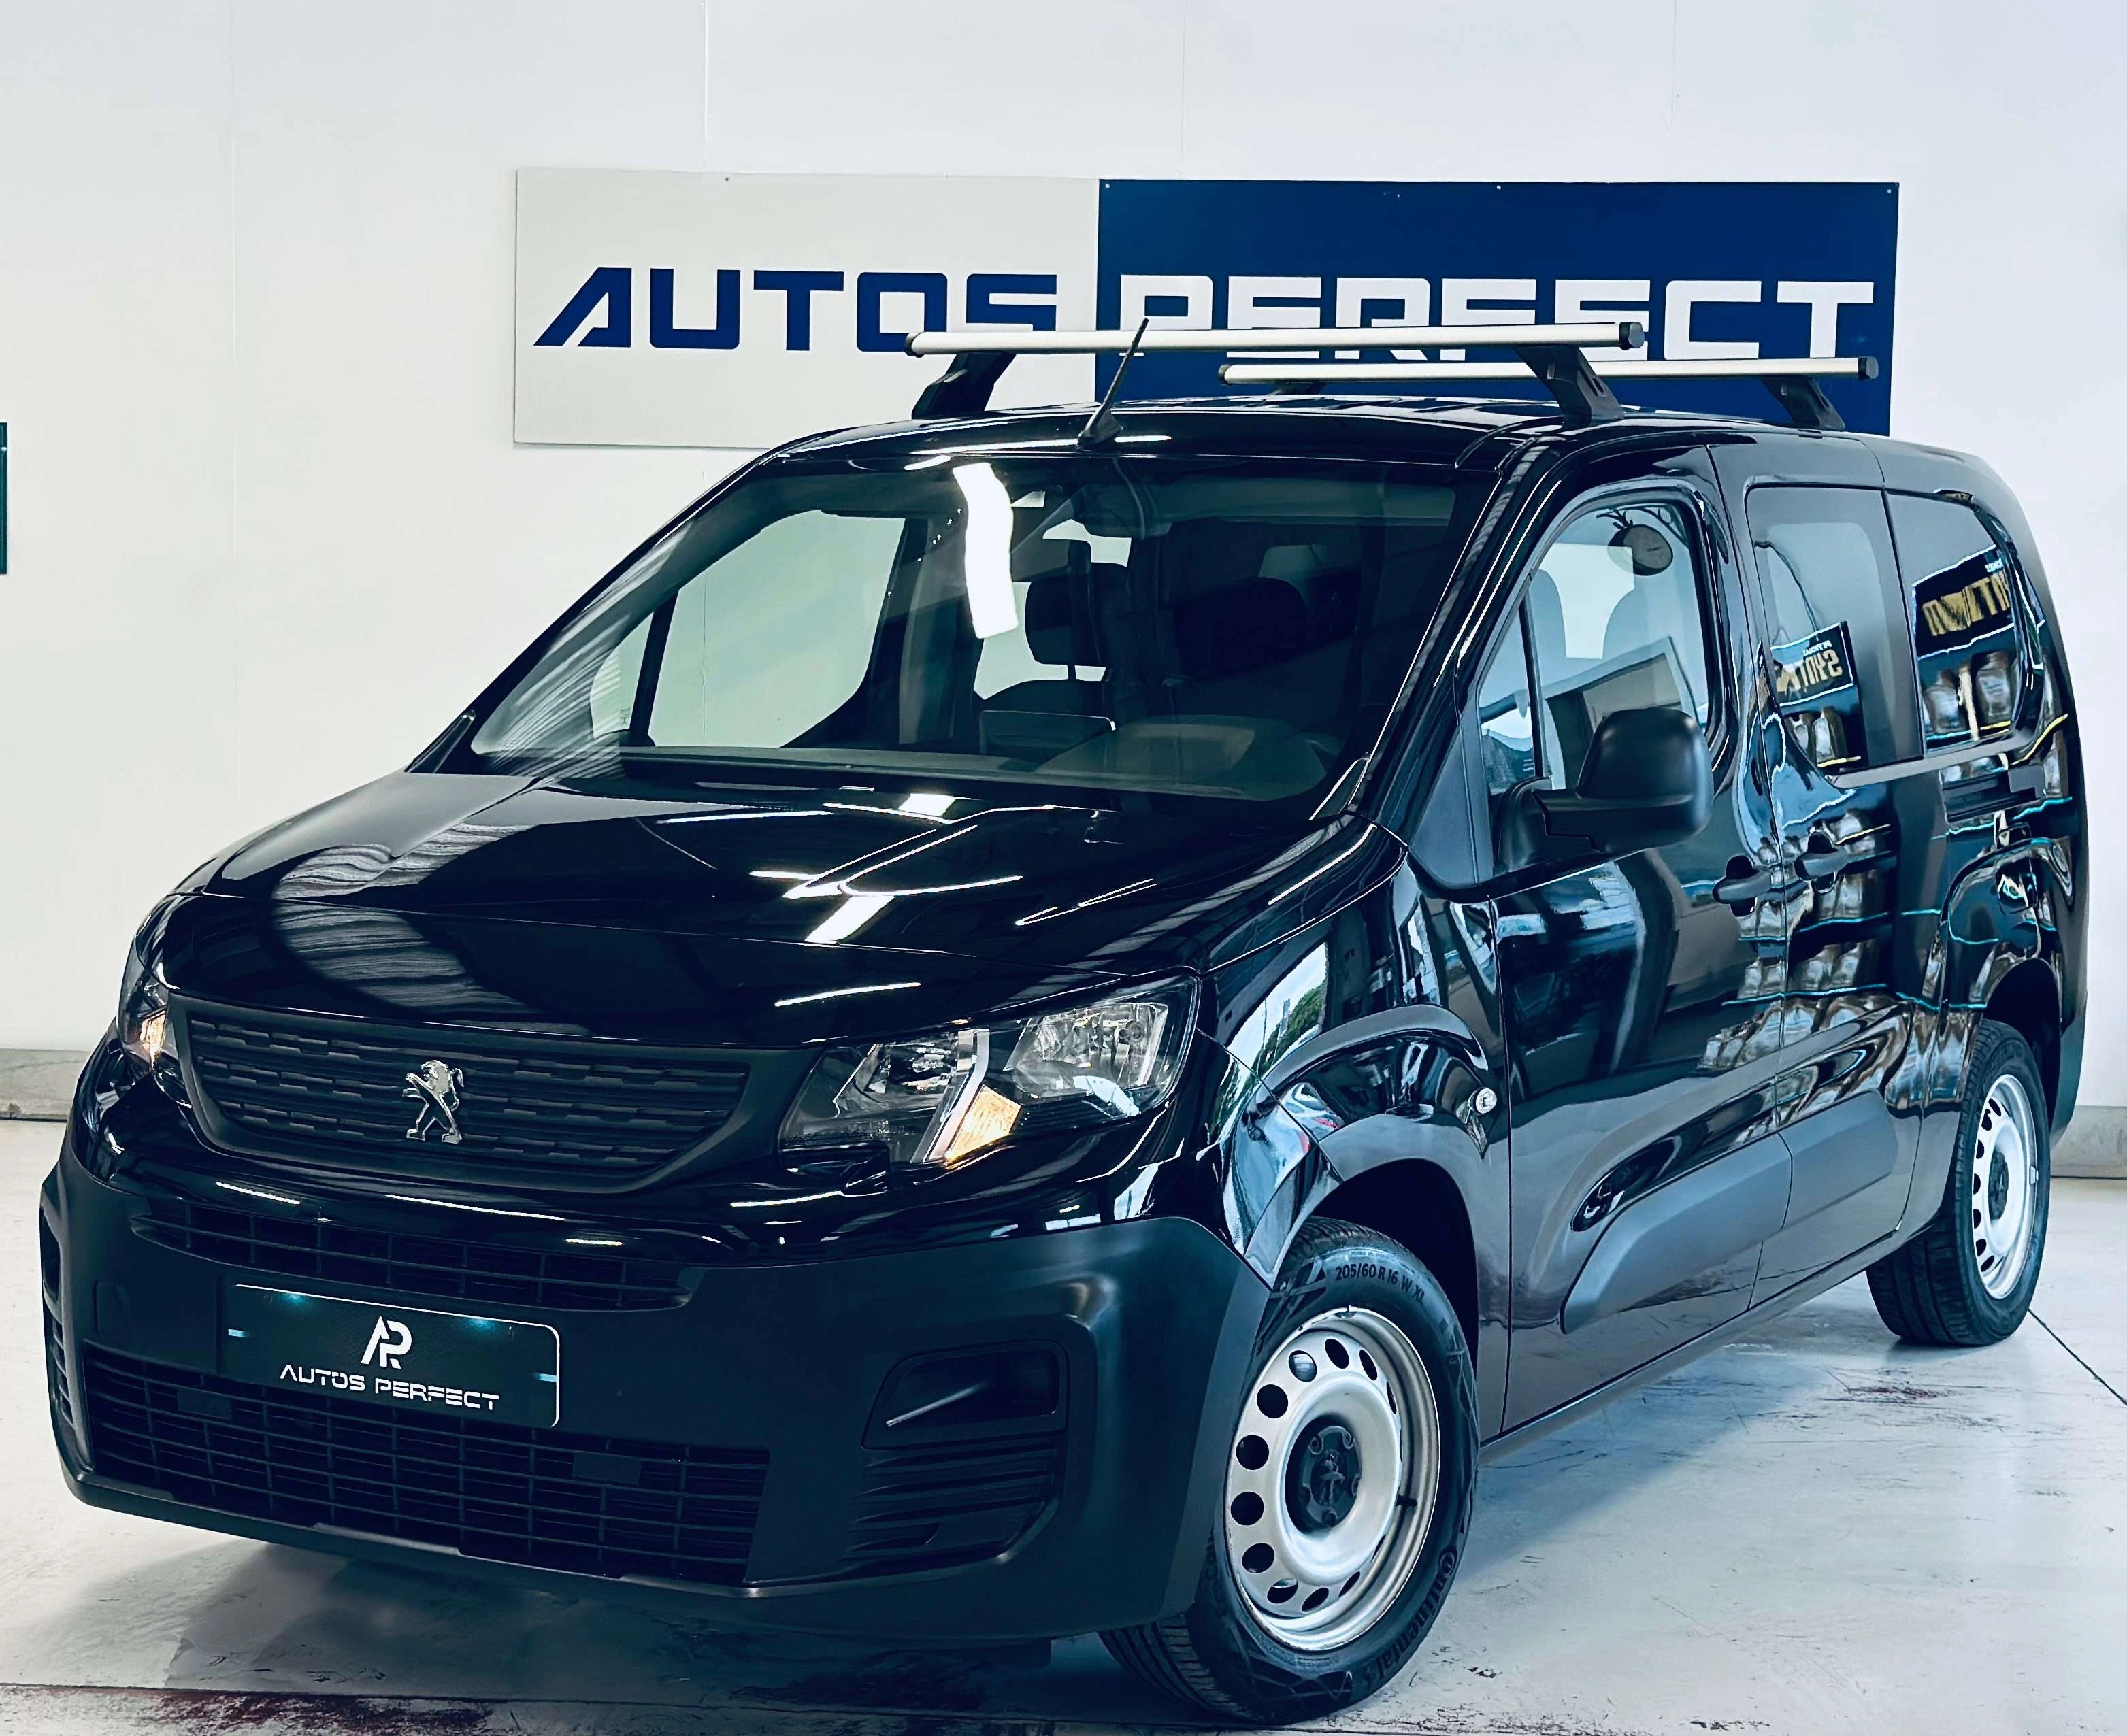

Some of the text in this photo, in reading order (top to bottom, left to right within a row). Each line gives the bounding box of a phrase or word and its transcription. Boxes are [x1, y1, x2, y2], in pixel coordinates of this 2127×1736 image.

[533, 267, 1874, 361] AUTOS PERFECT
[1336, 1262, 1376, 1281] 205/60
[1378, 1268, 1387, 1281] R
[1387, 1269, 1399, 1285] 16
[1413, 1285, 1425, 1302] XL
[280, 1364, 500, 1410] AUTOS PERFECT
